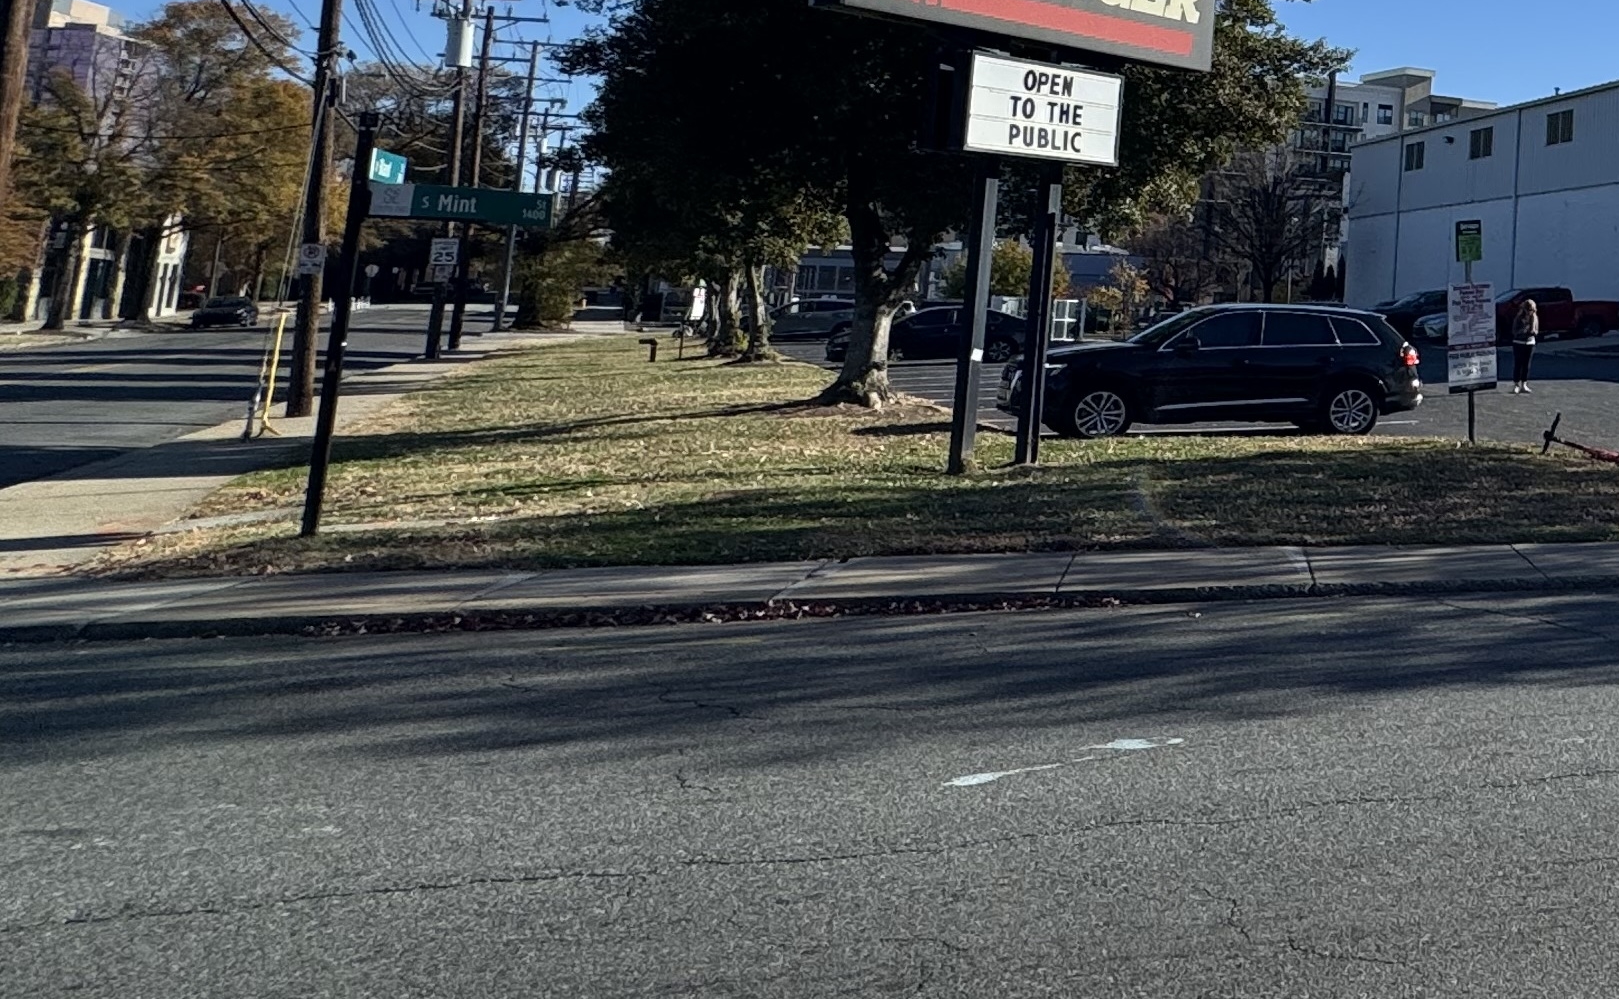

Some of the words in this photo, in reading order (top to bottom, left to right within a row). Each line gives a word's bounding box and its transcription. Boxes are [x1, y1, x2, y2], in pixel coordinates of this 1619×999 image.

[1023, 69, 1074, 98] OPEN
[1010, 95, 1037, 120] TO
[1046, 100, 1084, 127] THE
[1008, 123, 1083, 154] PUBLIC
[421, 196, 430, 208] S
[437, 194, 477, 213] Mint
[536, 199, 547, 211] St
[522, 208, 546, 220] 1400
[432, 251, 455, 263] 25
